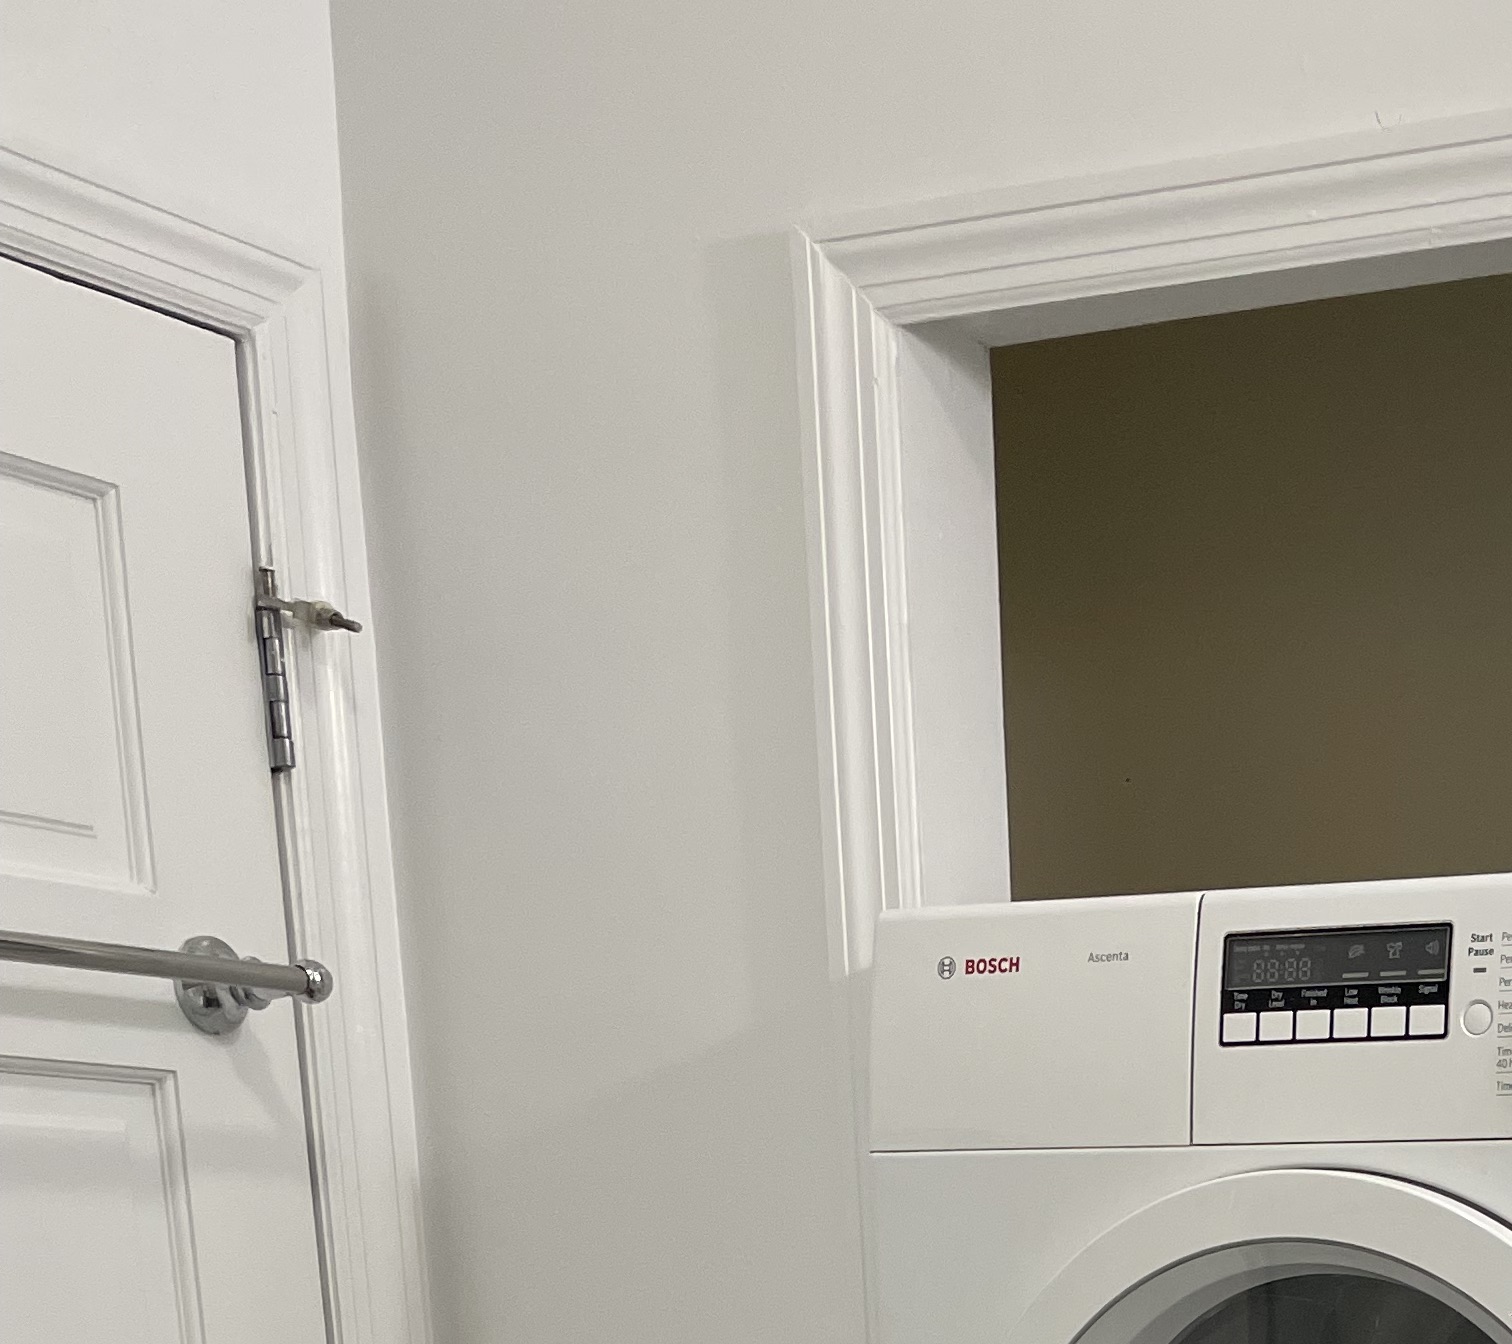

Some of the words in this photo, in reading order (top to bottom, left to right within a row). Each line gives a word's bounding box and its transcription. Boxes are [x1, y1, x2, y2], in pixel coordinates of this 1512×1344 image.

[1471, 933, 1493, 942] Start
[1468, 947, 1494, 956] Pause
[1088, 952, 1129, 962] Ascenta
[965, 957, 1020, 974] BOSCH
[1496, 1059, 1508, 1068] 40
